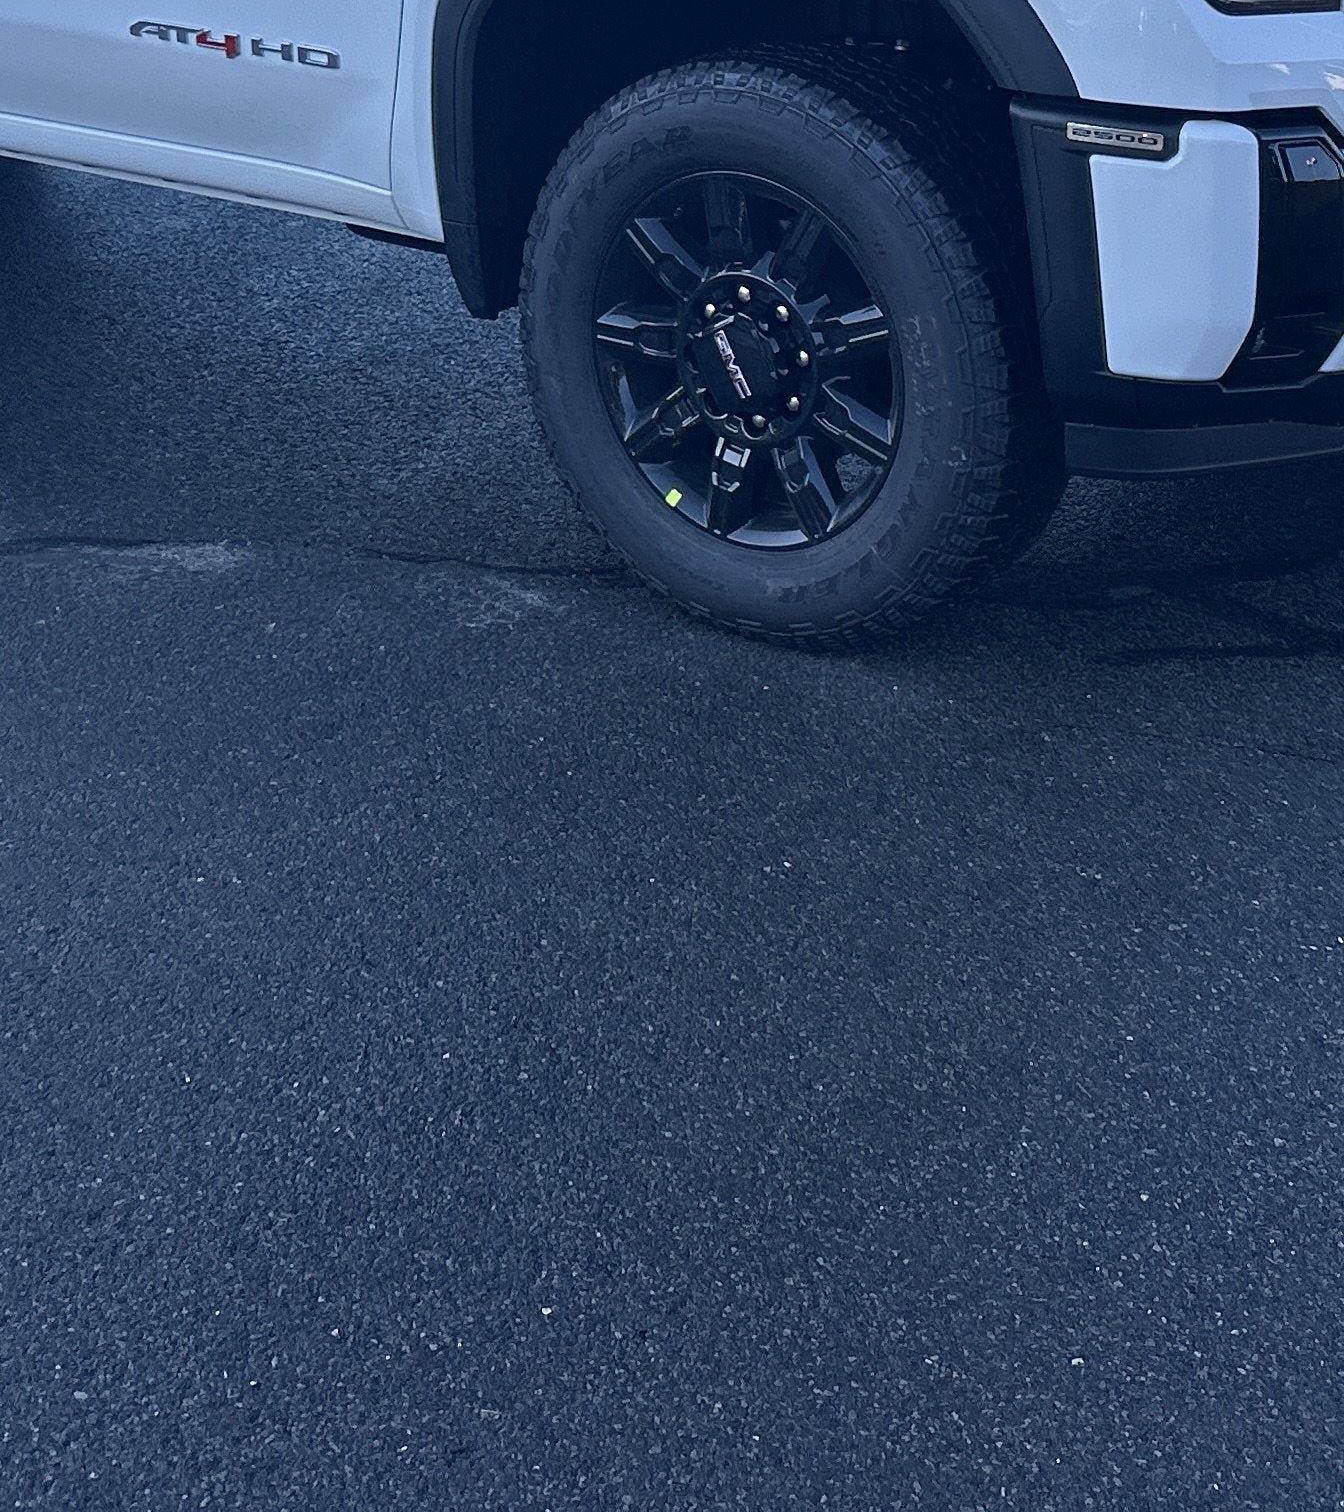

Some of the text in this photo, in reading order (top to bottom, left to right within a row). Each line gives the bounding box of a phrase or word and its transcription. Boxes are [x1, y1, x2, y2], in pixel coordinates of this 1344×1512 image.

[129, 19, 341, 70] AT4 HD
[1071, 128, 1159, 146] 2500
[713, 329, 752, 399] GMC
